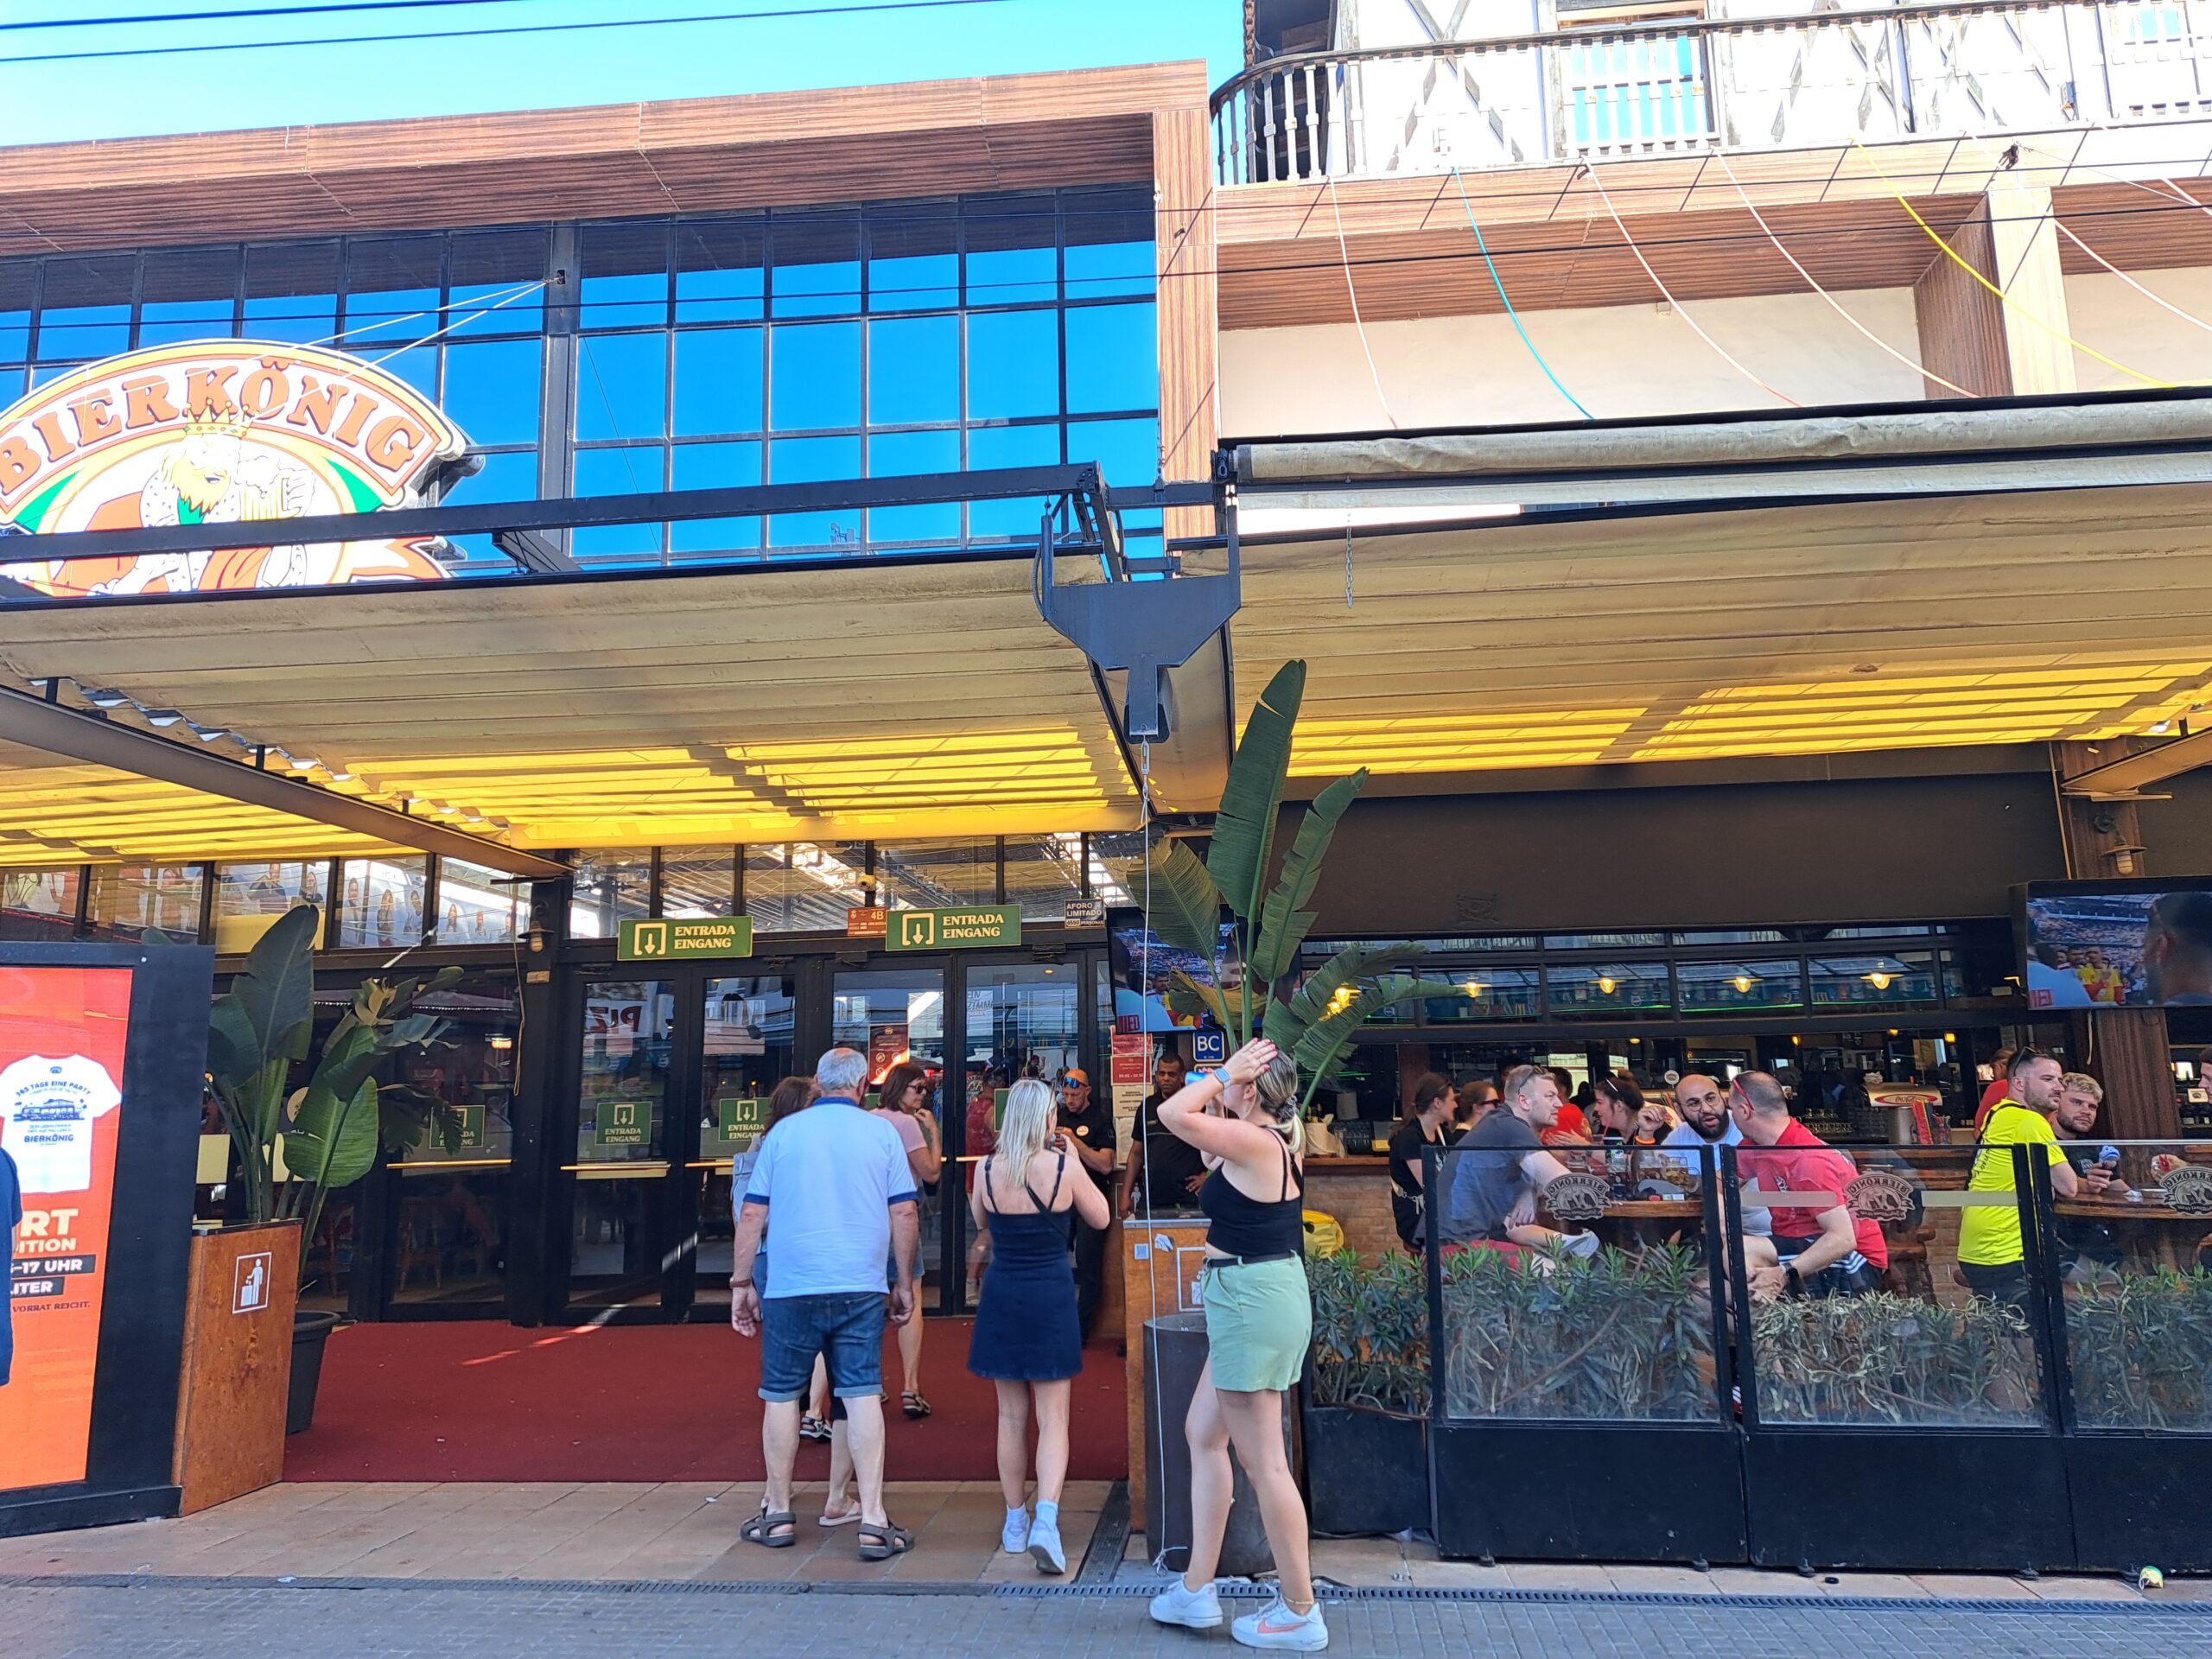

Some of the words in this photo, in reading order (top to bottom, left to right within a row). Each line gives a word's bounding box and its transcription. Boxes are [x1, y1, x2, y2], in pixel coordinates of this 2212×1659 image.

[0, 359, 426, 496] BIERKÖNIG
[870, 910, 884, 920] 4B
[942, 913, 1004, 926] ENTRADA
[673, 925, 736, 937] ENTRADA
[942, 927, 1001, 939] EINGANG
[673, 938, 732, 950] EINGANG
[1197, 1035, 1220, 1052] BC
[30, 1081, 49, 1090] TAGE
[69, 1082, 92, 1095] PARTY
[605, 1127, 642, 1135] ENTRADA
[728, 1123, 765, 1132] ENTRADA
[24, 1133, 74, 1143] BIERKÖNIG
[20, 1208, 79, 1237] RT
[16, 1238, 77, 1254] ITION
[44, 1259, 83, 1273] UHR
[12, 1304, 52, 1313] VORRAT
